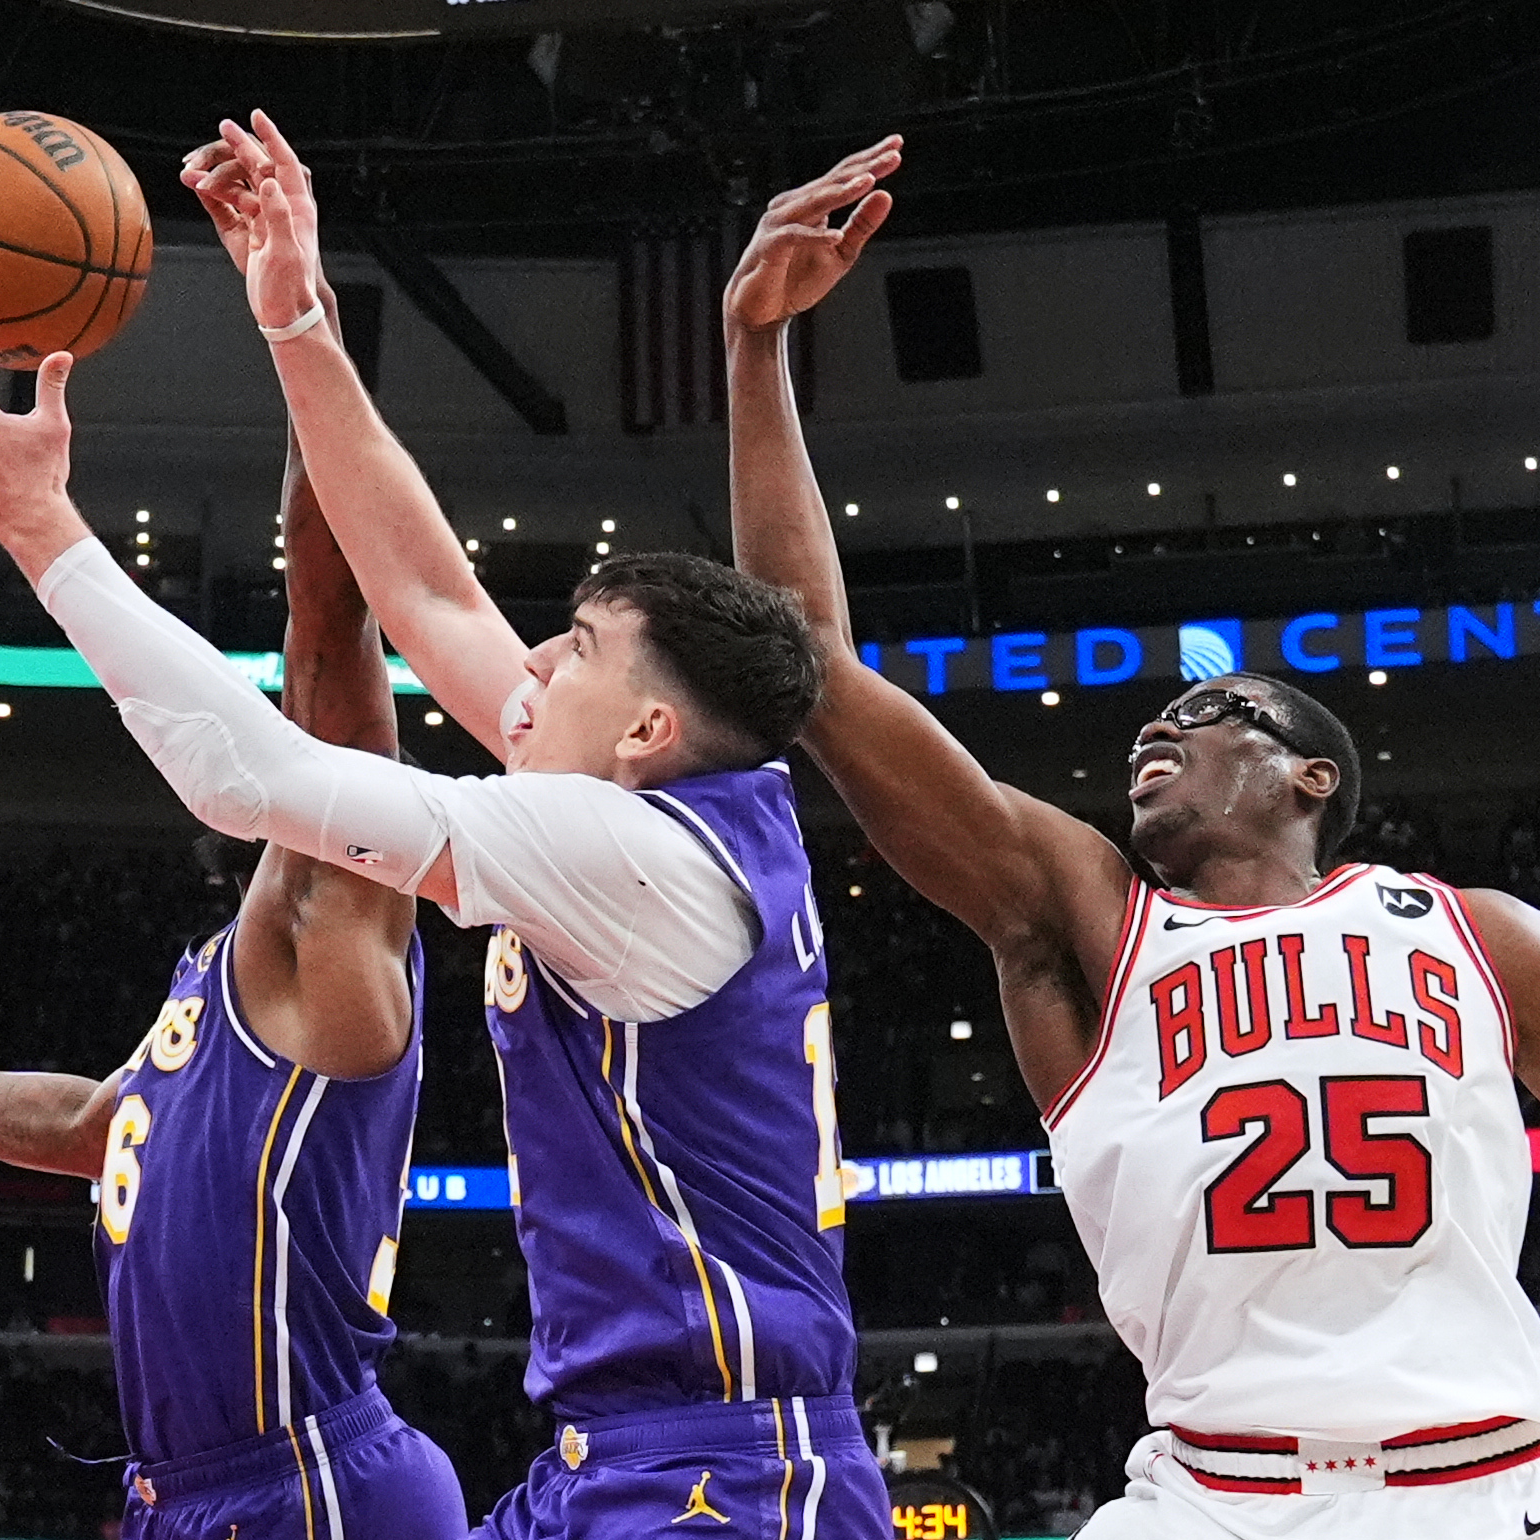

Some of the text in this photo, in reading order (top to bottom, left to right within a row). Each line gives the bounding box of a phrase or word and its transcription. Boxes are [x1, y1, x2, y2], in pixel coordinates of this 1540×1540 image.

[3, 112, 86, 172] Wil
[861, 628, 1143, 696] TED
[1149, 933, 1465, 1102] BULLS
[404, 1173, 467, 1201] UB
[1200, 1074, 1434, 1255] 25
[892, 1504, 968, 1540] 4:34
